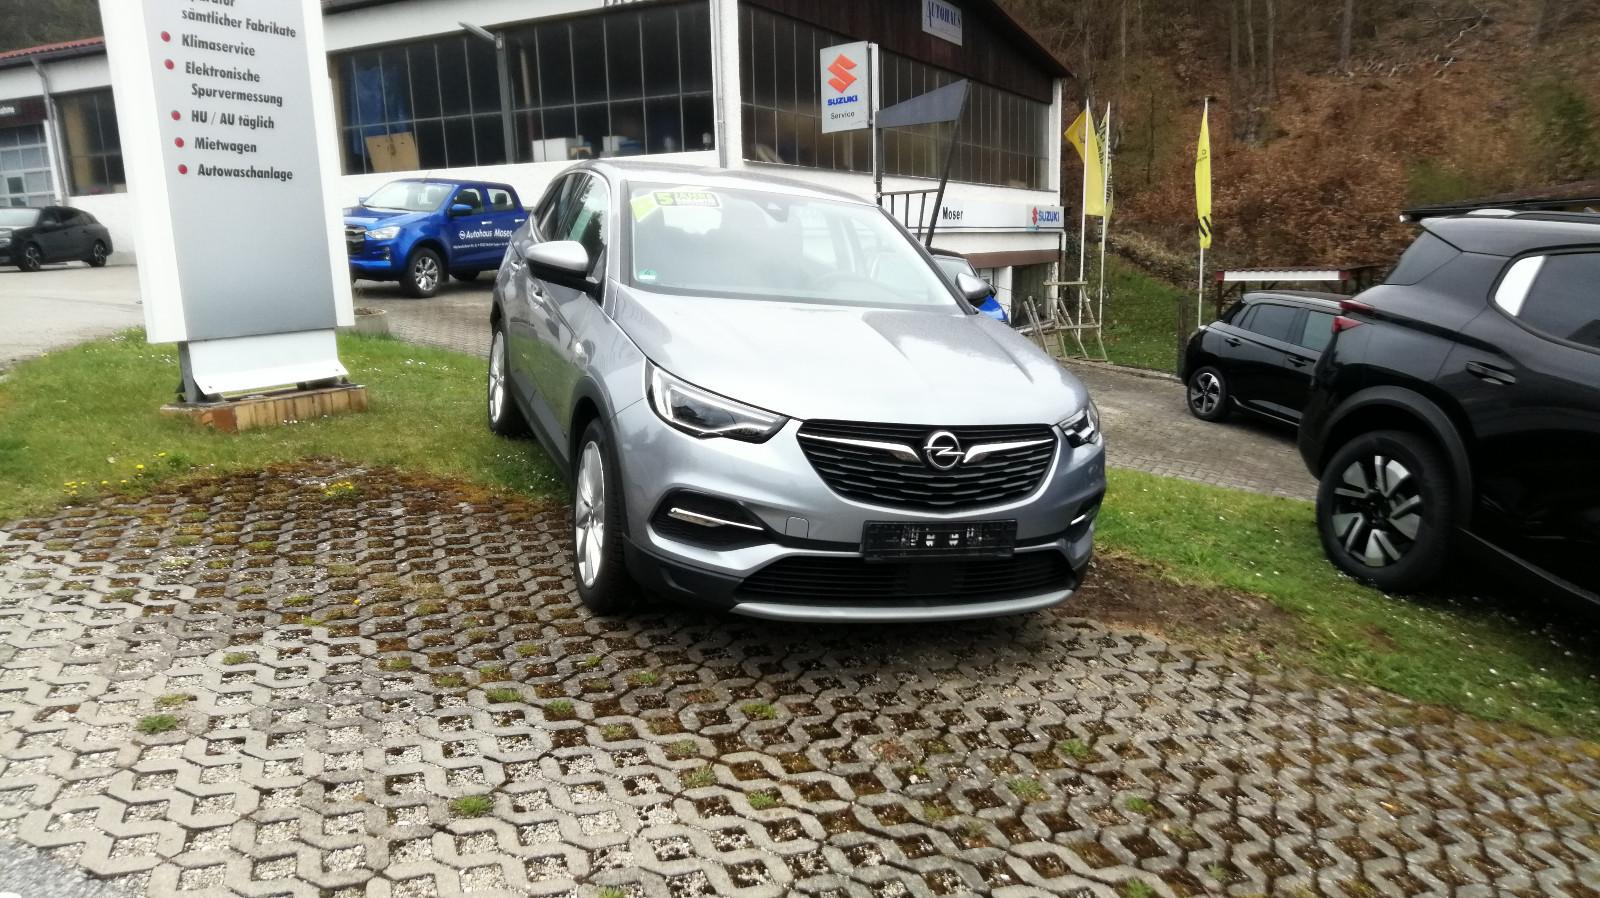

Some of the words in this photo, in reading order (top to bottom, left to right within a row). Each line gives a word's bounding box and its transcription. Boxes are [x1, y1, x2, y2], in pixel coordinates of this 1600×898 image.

[181, 8, 242, 28] sämtlicher
[245, 17, 297, 38] Fabrikate
[181, 33, 256, 56] Klimaservice
[185, 61, 261, 83] Elektronische
[191, 83, 283, 107] Spurvermessung
[827, 95, 858, 106] SUZUKI
[191, 110, 208, 123] HU
[219, 112, 236, 126] AU
[238, 115, 275, 130] täglich
[830, 112, 855, 120] Service
[194, 137, 257, 155] Mietwagen
[197, 163, 293, 182] Autowaschanlage
[942, 206, 964, 221] Moser
[1038, 210, 1060, 223] SUZUKI
[466, 230, 493, 239] Autohaus
